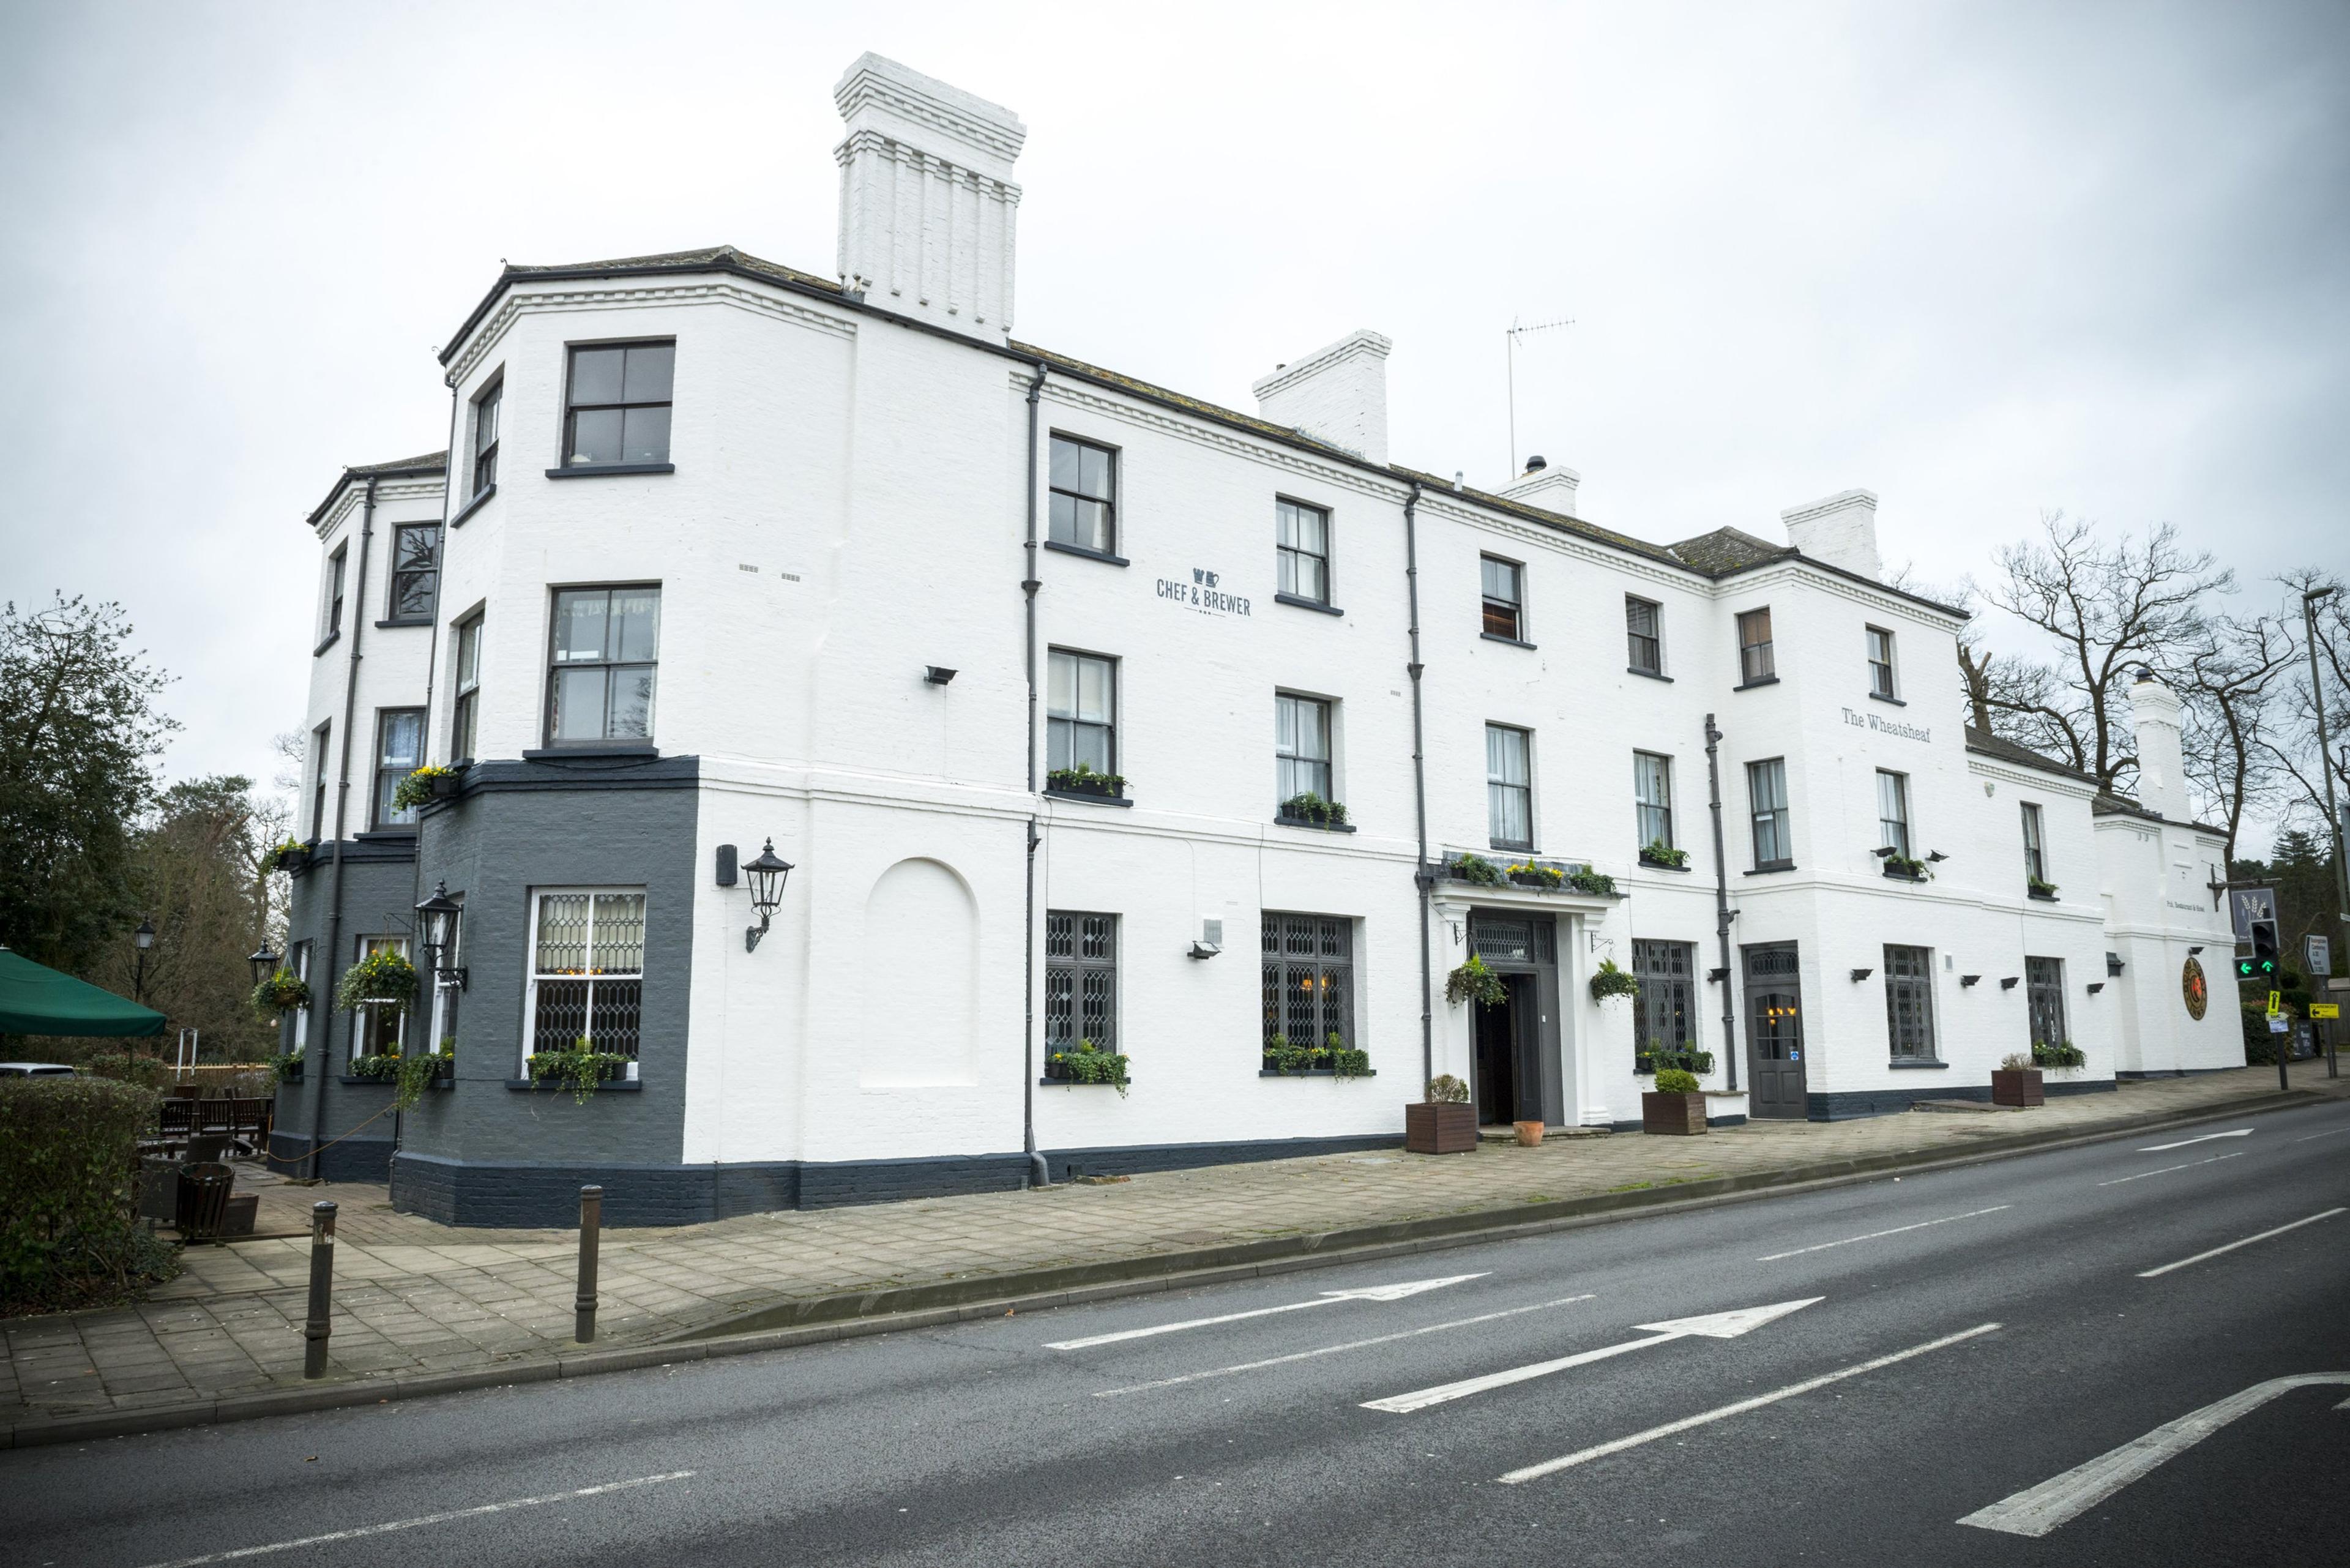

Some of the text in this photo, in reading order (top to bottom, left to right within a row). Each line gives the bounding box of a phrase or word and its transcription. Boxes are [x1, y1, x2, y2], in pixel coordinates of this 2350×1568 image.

[1157, 578, 1251, 617] CHEF & BREWER
[1841, 707, 1931, 743] The Wheatsheaf
